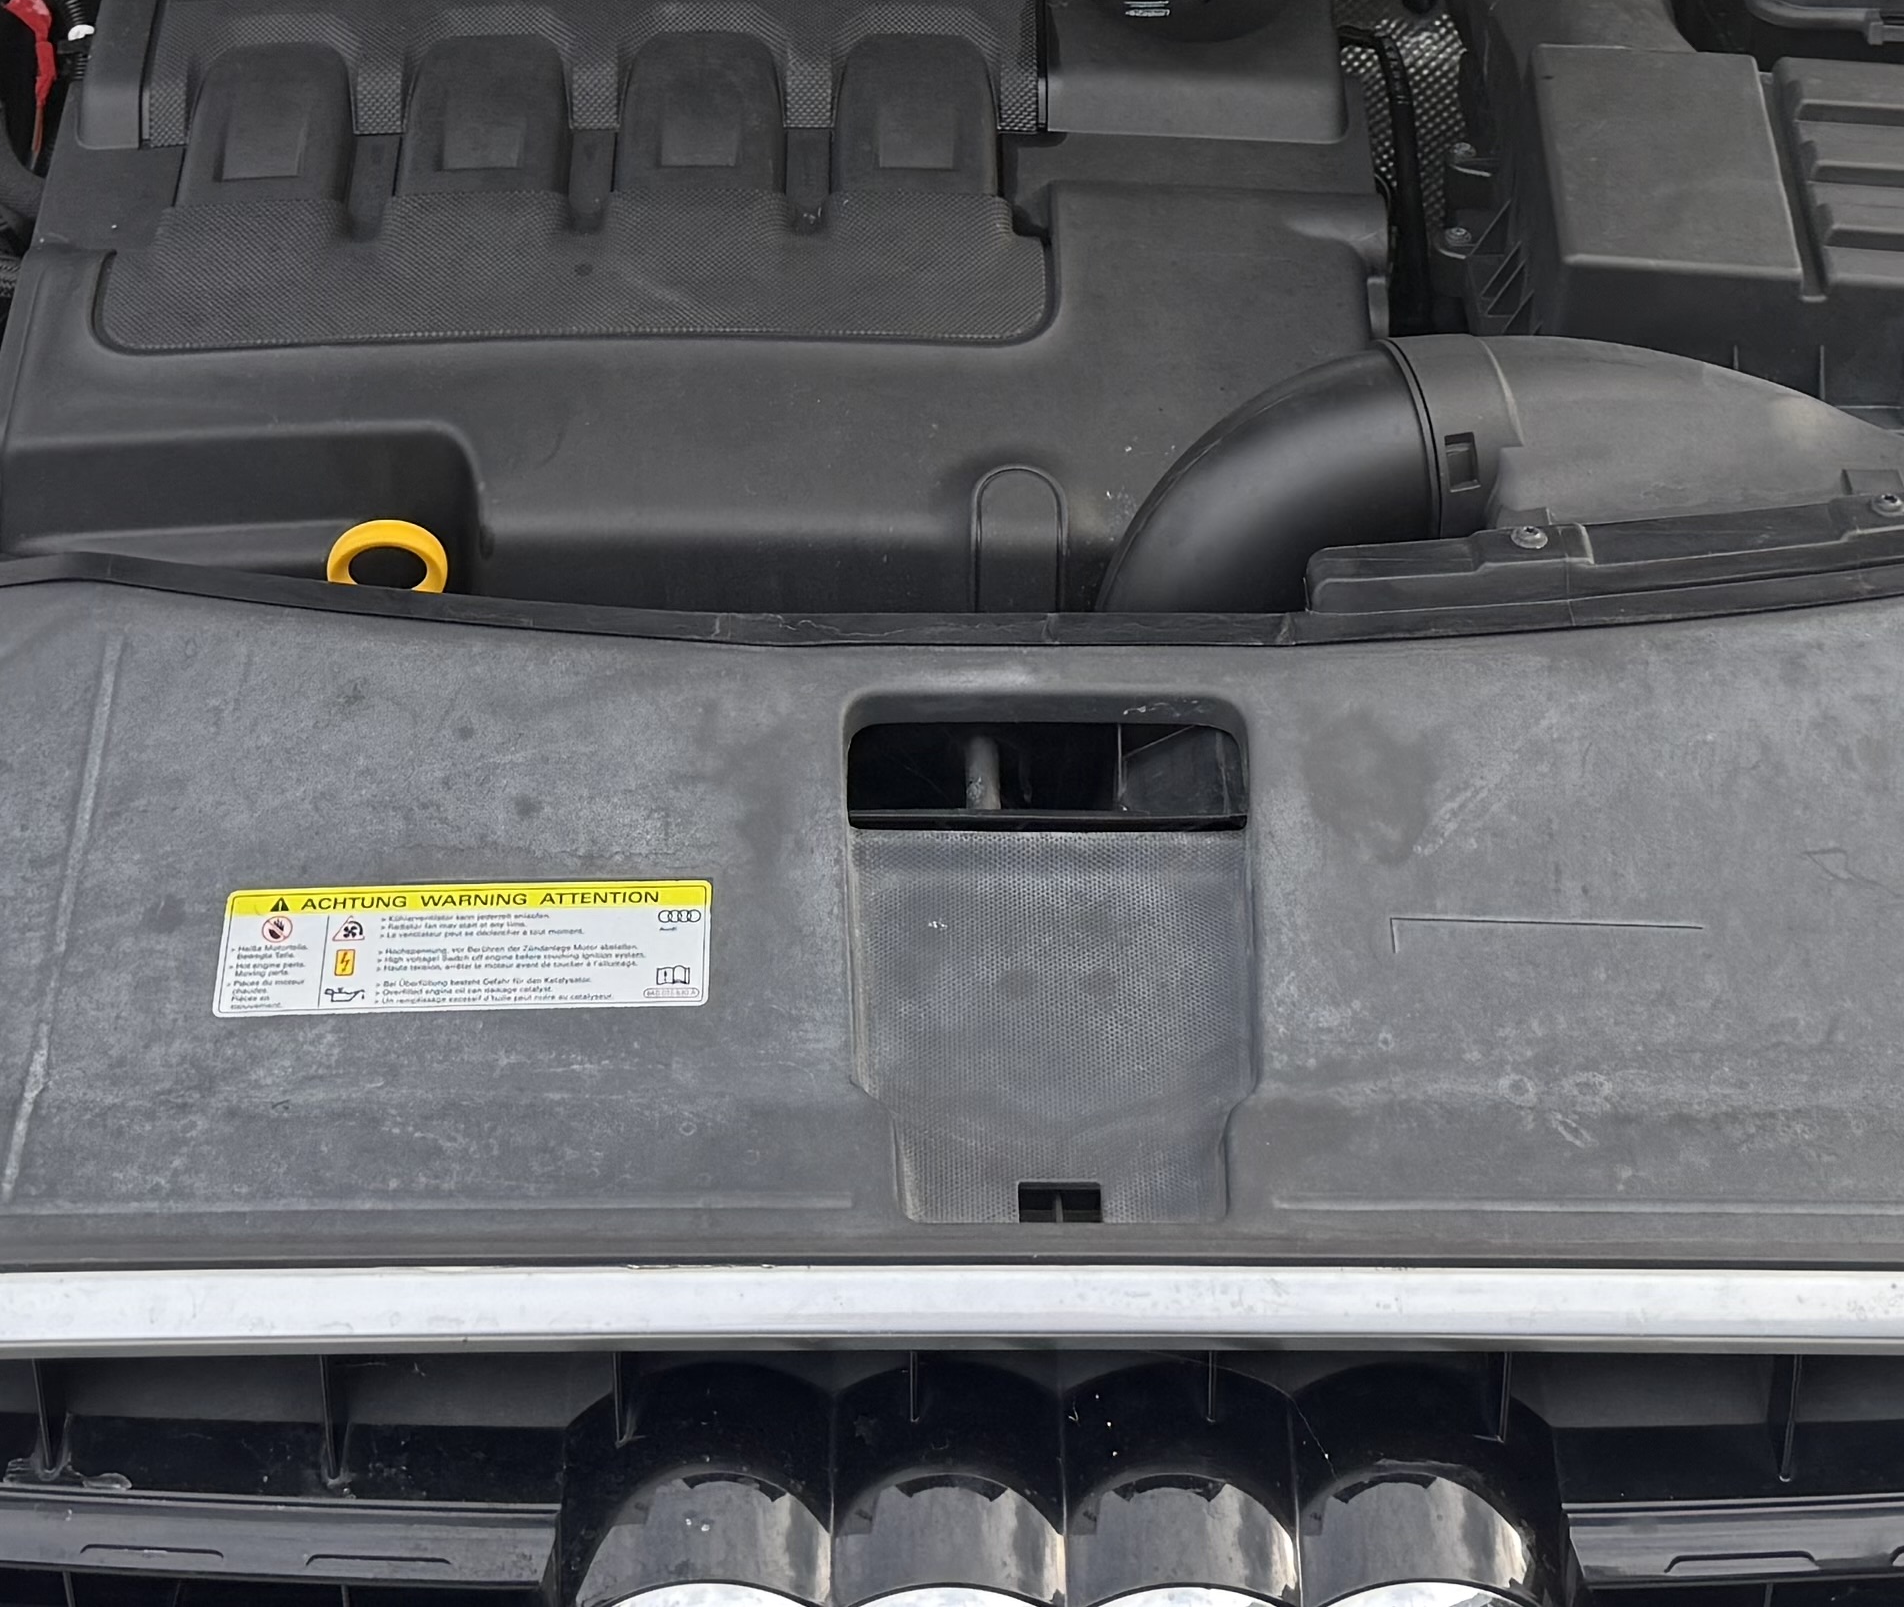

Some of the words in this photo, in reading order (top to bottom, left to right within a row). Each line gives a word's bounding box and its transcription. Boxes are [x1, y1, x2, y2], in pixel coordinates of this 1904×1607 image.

[301, 896, 407, 910] ACHTUNG
[420, 893, 527, 907] WARNING
[540, 891, 659, 904] ATTENTION
